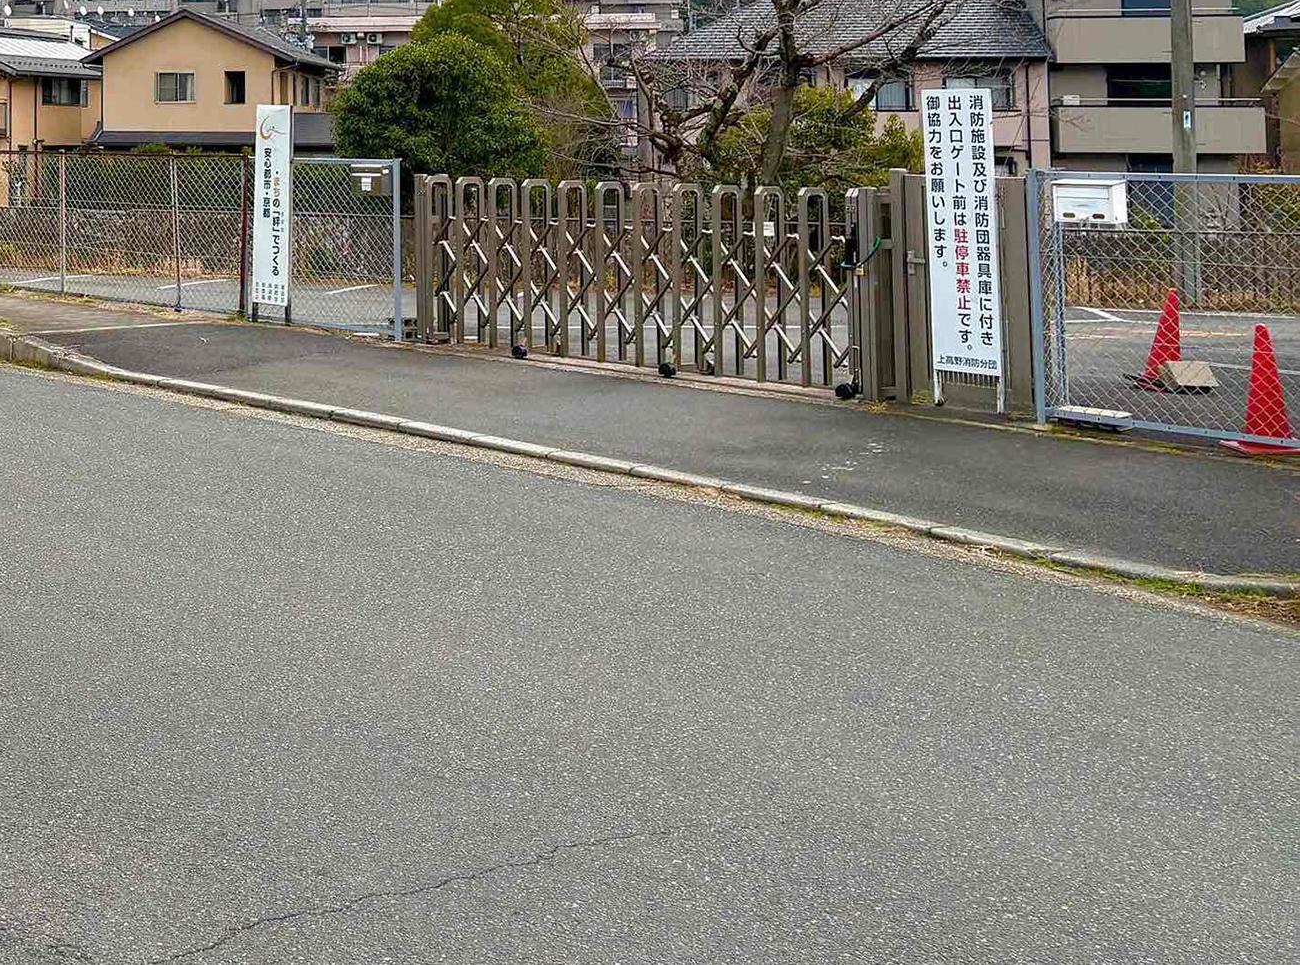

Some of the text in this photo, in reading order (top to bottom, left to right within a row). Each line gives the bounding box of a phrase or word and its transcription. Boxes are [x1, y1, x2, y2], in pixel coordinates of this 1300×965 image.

[926, 96, 948, 268] 御協力をお願いします。
[948, 95, 973, 350] 出入口ゲート前は駐停車禁止です。
[969, 95, 994, 346] 消防施設及び消防団器具庫に付き
